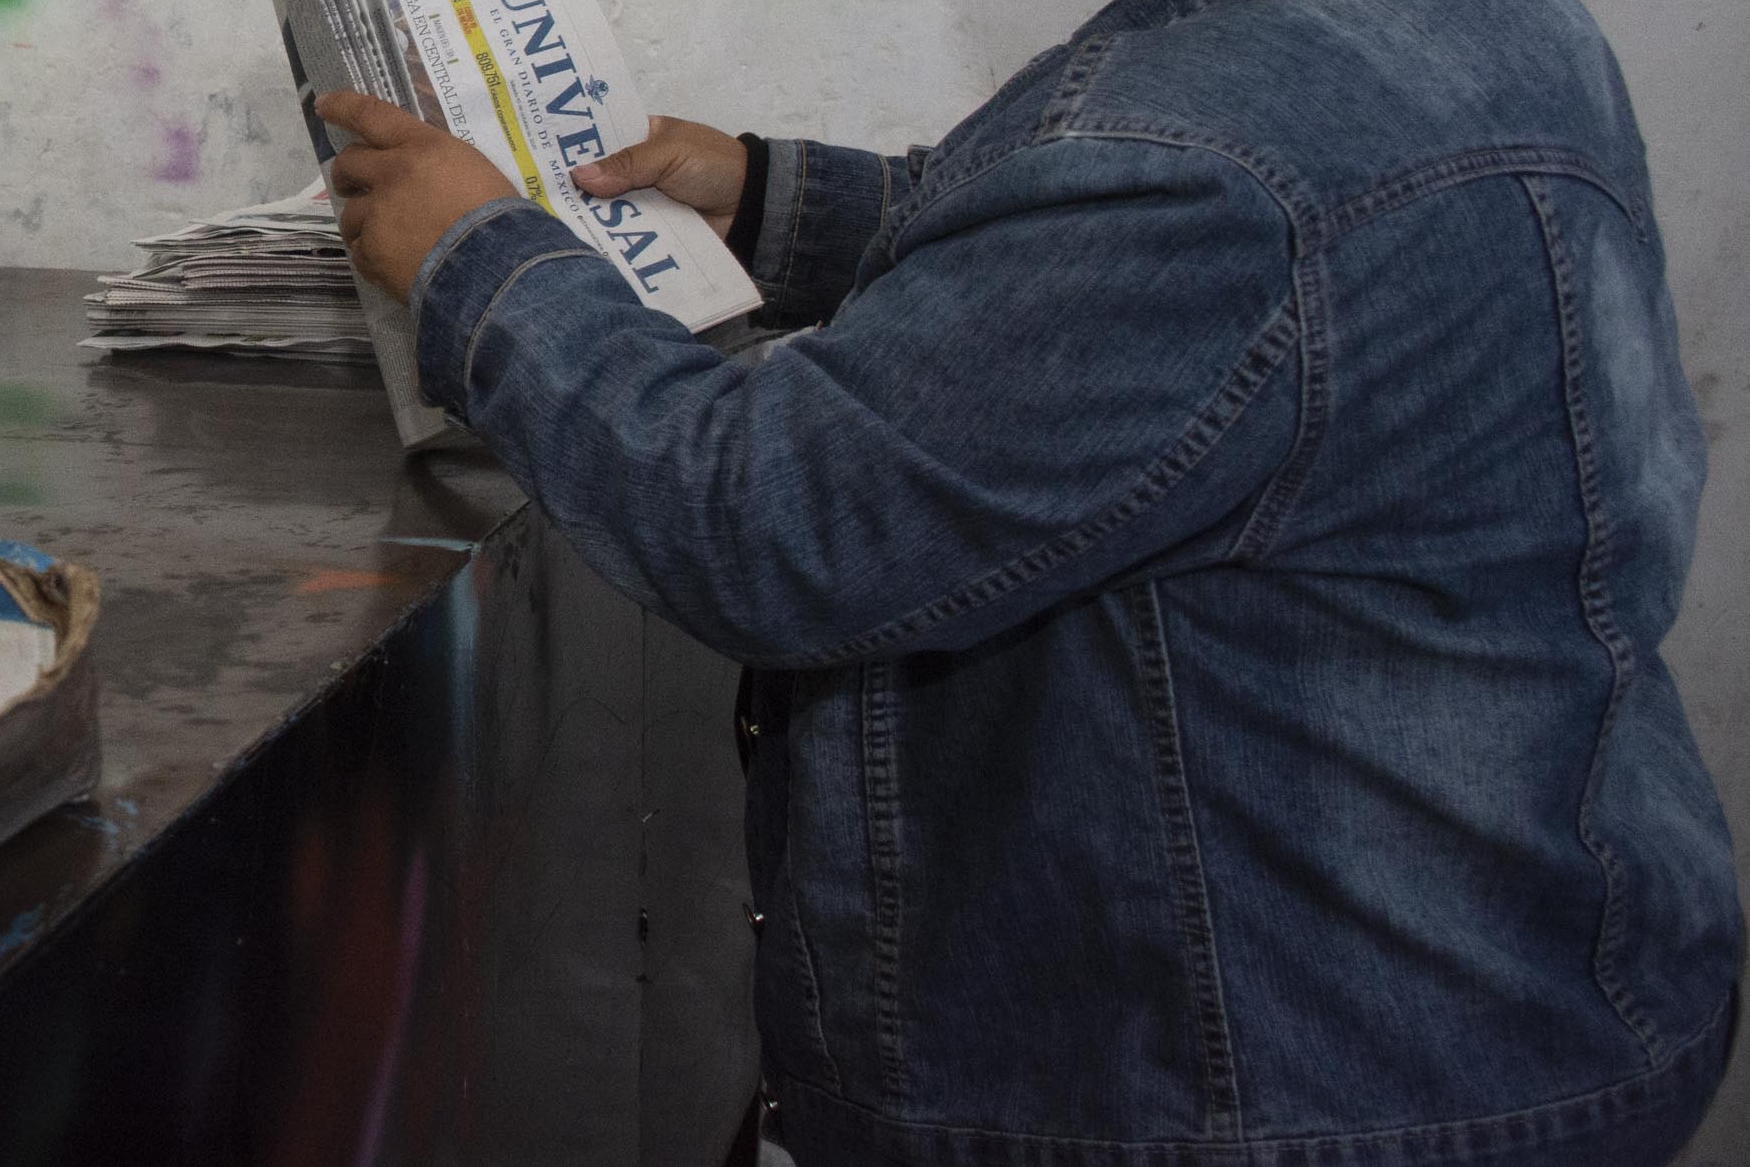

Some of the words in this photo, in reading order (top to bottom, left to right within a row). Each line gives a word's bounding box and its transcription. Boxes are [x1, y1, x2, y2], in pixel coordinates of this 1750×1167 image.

[411, 15, 431, 38] EN
[420, 36, 458, 105] CENTRAL
[489, 7, 502, 24] EL
[498, 28, 522, 67] GRAN
[517, 70, 543, 125] DIARIO
[446, 102, 467, 127] DE
